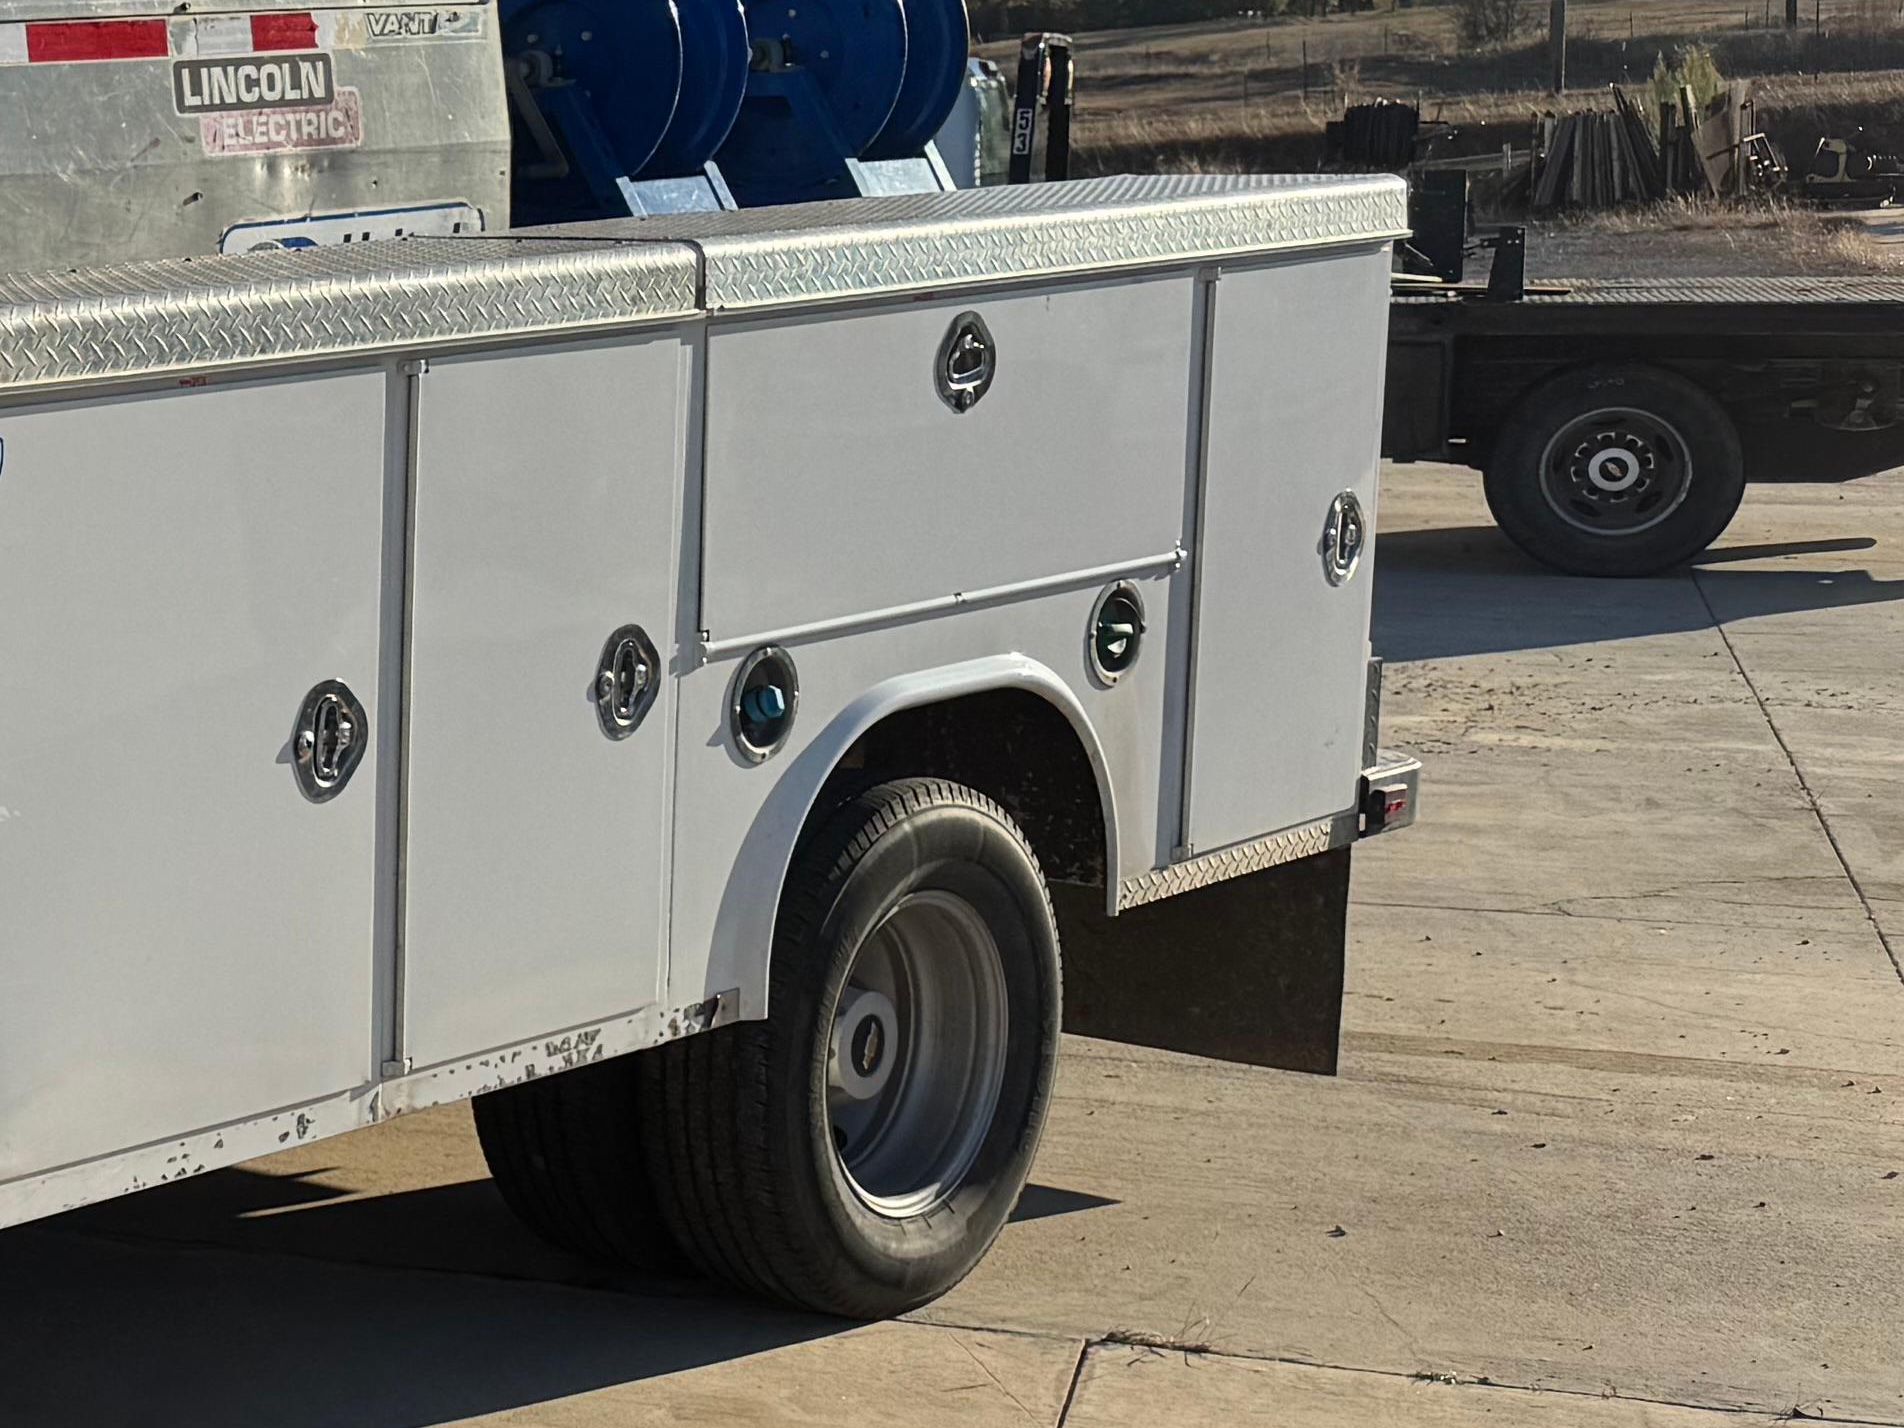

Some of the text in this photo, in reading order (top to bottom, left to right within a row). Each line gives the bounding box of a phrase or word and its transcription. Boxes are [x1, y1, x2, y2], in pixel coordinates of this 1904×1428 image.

[365, 10, 440, 38] VANT
[180, 61, 326, 107] LINCOLN
[223, 110, 347, 146] ELECTRIC
